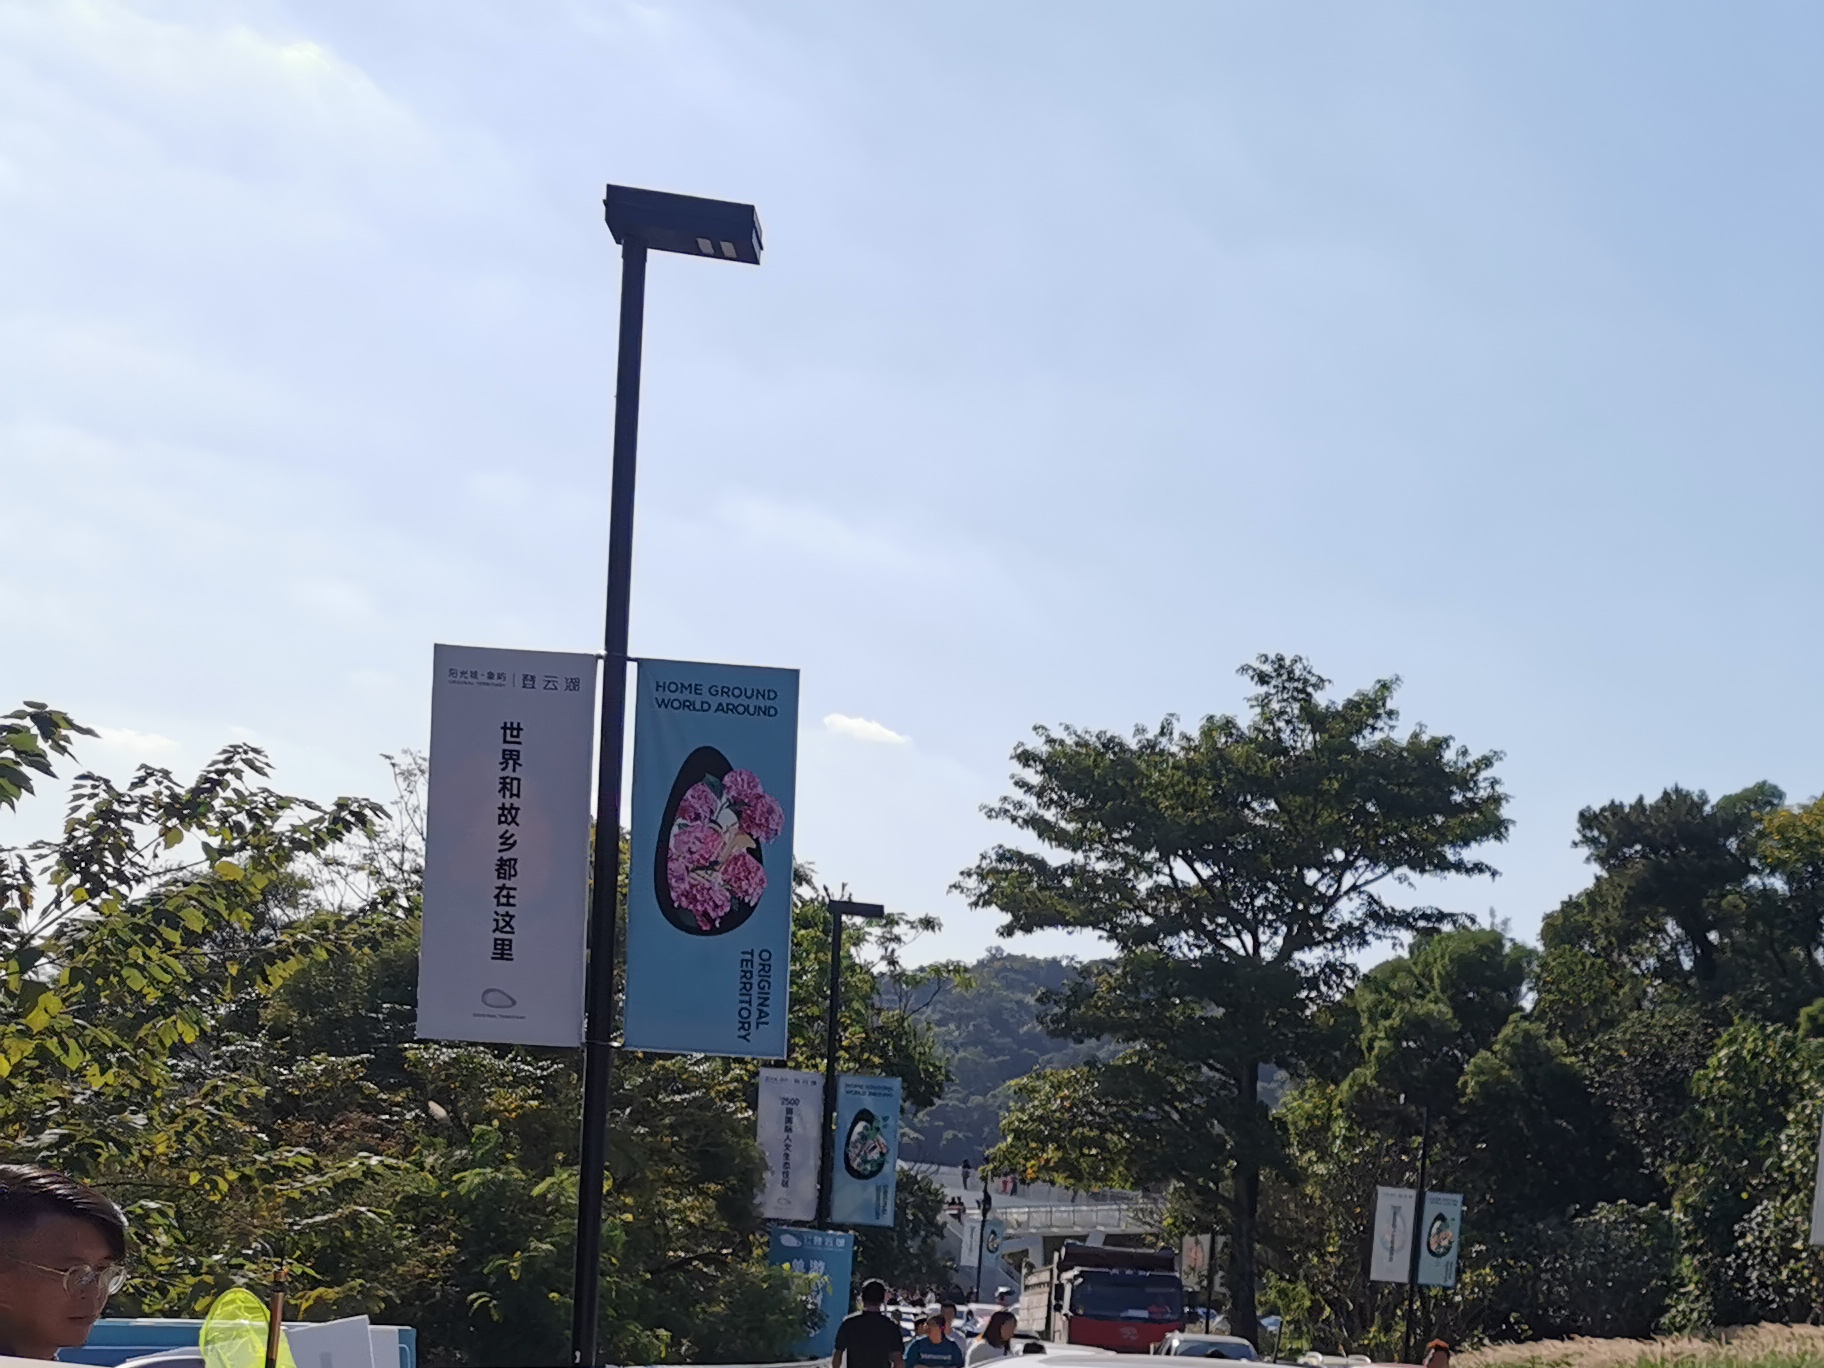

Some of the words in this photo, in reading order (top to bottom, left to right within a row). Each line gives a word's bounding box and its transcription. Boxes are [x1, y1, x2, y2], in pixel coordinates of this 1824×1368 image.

[521, 673, 581, 692] 登云湖
[654, 697, 712, 713] WORLD
[714, 702, 779, 718] AROUND
[655, 680, 703, 696] HOME
[708, 684, 778, 701] GROUND
[490, 721, 525, 962] 世界和故乡都在这里
[737, 947, 755, 1044] TERRITORY
[756, 948, 773, 1031] ORIGINAL
